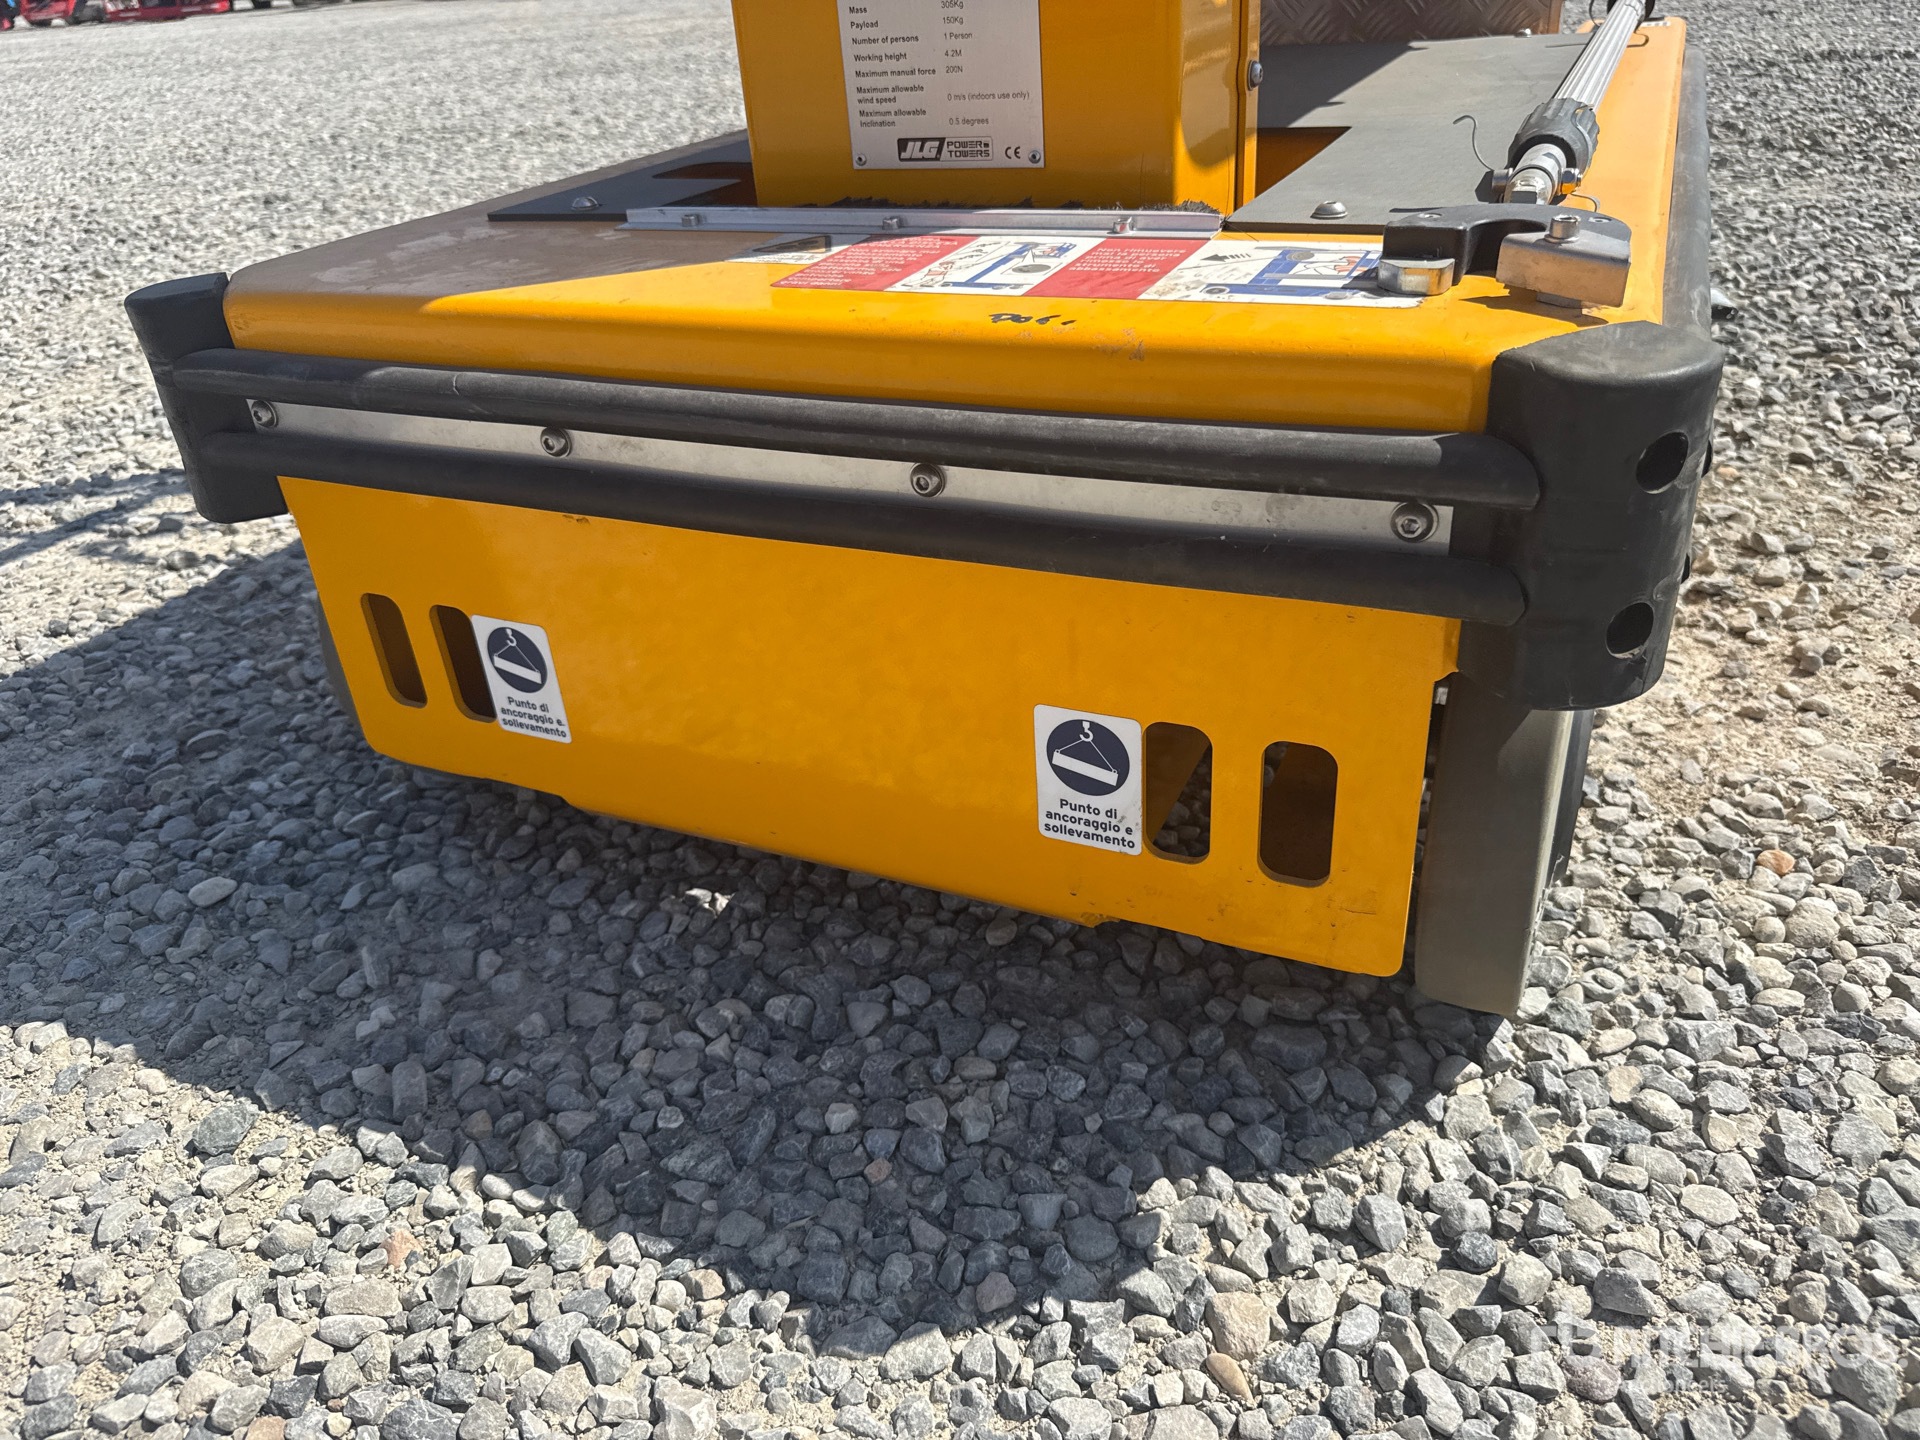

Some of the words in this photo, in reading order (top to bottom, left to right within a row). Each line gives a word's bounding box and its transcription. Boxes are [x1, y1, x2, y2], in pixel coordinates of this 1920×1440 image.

[941, 0, 964, 9] 305Kg
[849, 6, 868, 14] Mass
[850, 20, 879, 30] Payload
[942, 16, 964, 25] 150Kg
[852, 36, 880, 45] Number
[881, 36, 889, 44] of
[890, 35, 919, 44] persons
[949, 32, 973, 40] Person
[854, 54, 883, 62] Working
[884, 53, 907, 61] height
[855, 70, 887, 78] Maximum
[890, 68, 916, 76] manual
[945, 65, 963, 74] 200N
[856, 86, 889, 94] Maximum
[891, 84, 924, 93] allowable
[875, 96, 897, 105] speed
[947, 93, 952, 101] 0
[953, 93, 966, 101] m/s
[968, 91, 996, 101] (indoors
[1011, 91, 1030, 100] only)
[893, 108, 926, 116] allowable
[860, 120, 896, 128] Inclination
[961, 116, 989, 126] degrees
[900, 140, 940, 159] JLG
[946, 140, 983, 149] POWER
[947, 149, 990, 158] TOWERS
[507, 696, 538, 710] Punto
[540, 703, 549, 713] di
[501, 707, 554, 724] ancoraggio
[502, 718, 567, 738] sollevamento
[1059, 798, 1101, 816] Punto
[1105, 808, 1117, 819] di
[1045, 810, 1121, 832] ancoraggio
[1125, 826, 1133, 836] e
[1044, 823, 1135, 849] sollevamento
